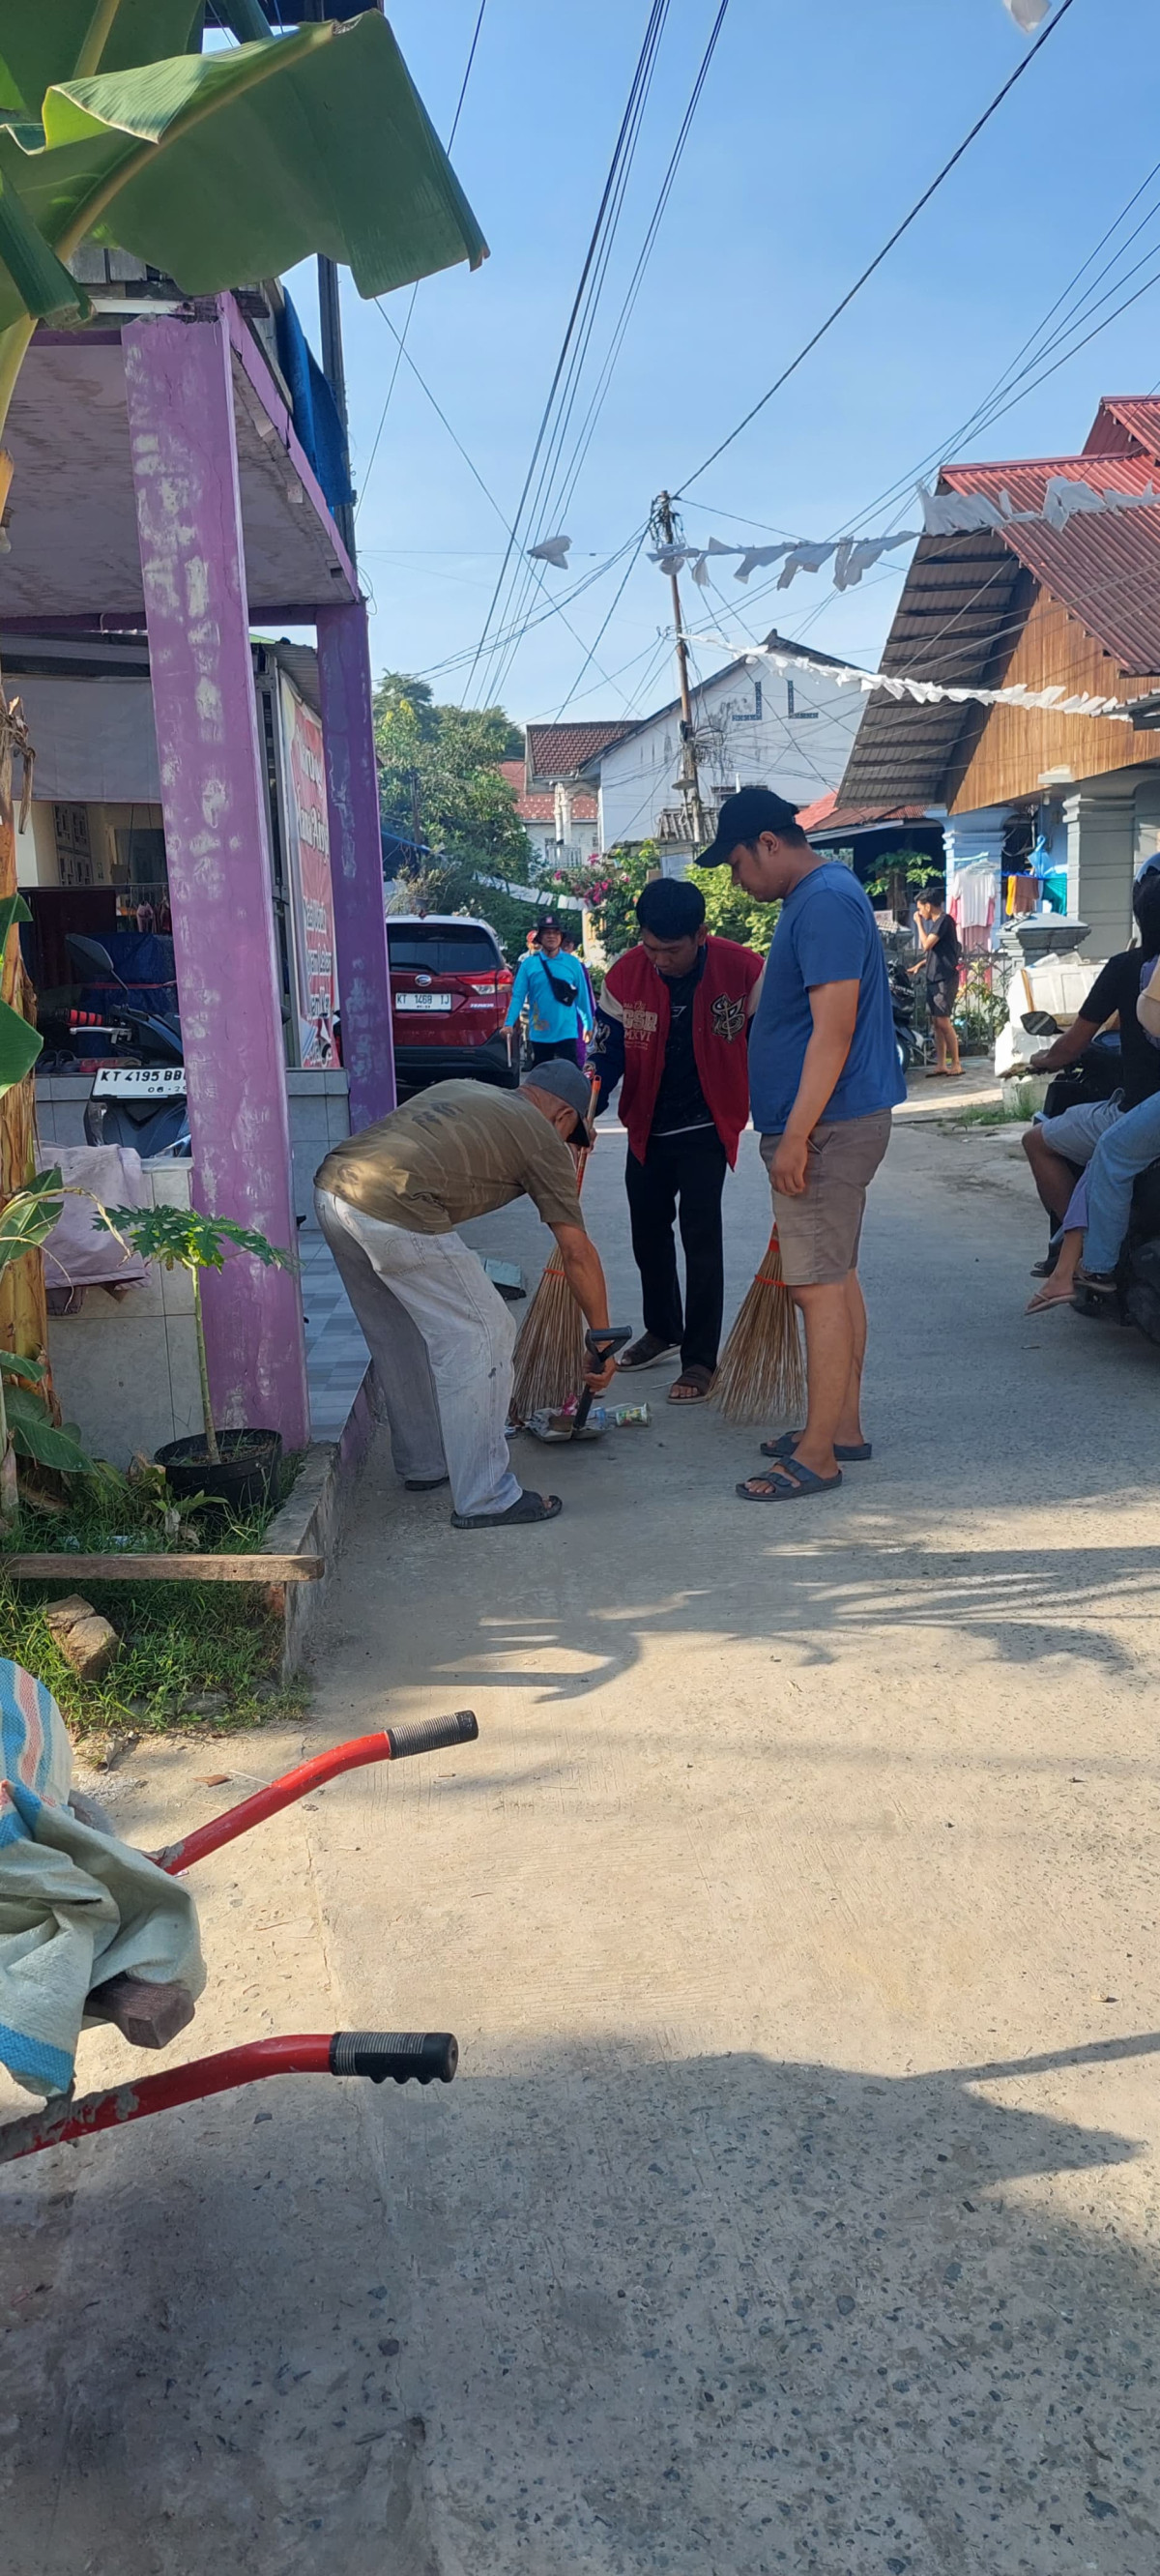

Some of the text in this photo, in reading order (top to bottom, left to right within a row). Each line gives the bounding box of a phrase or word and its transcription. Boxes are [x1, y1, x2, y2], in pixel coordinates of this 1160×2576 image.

[396, 995, 407, 1004] KT
[101, 1069, 186, 1082] KT 4195 BB
